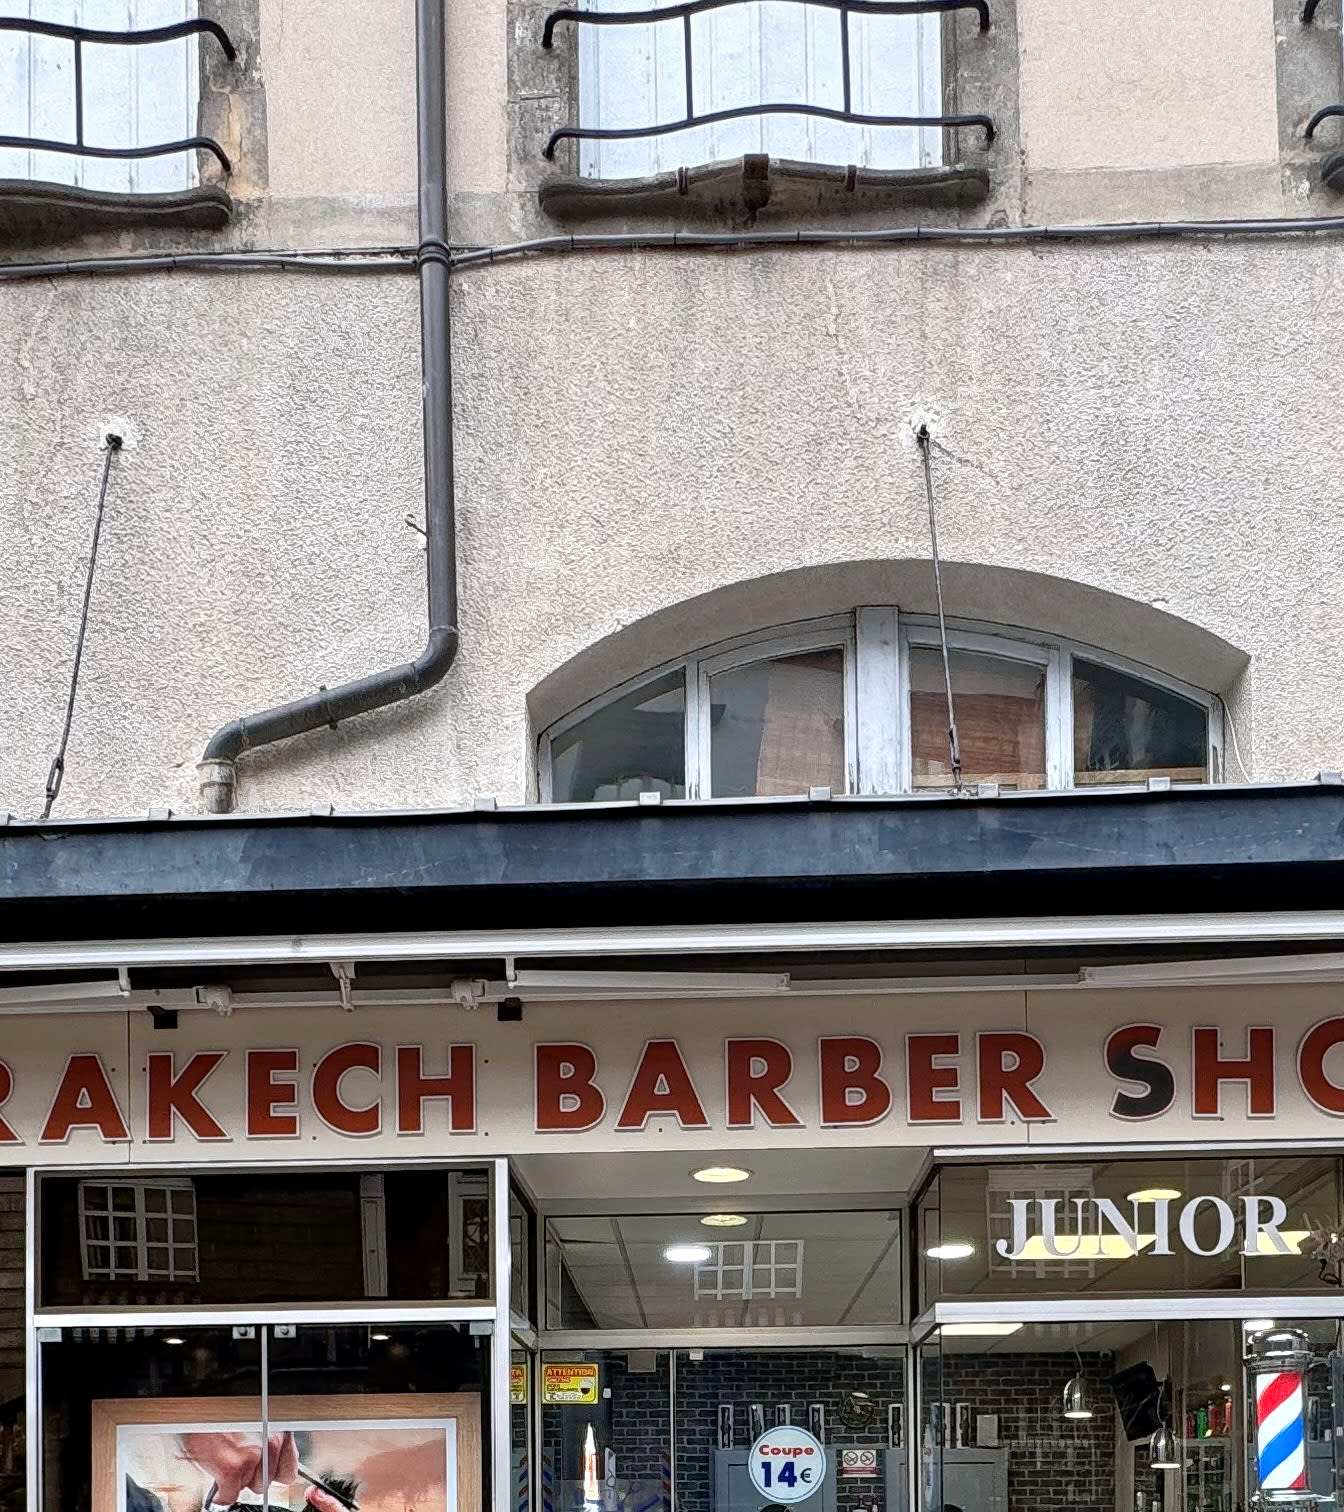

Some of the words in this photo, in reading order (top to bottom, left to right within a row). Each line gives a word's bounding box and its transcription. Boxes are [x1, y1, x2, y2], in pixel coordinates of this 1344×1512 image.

[533, 1029, 1058, 1134] BARBER
[995, 1195, 1298, 1258] JUNIOR
[758, 1444, 815, 1459] Coupe
[760, 1461, 813, 1488] 14€
